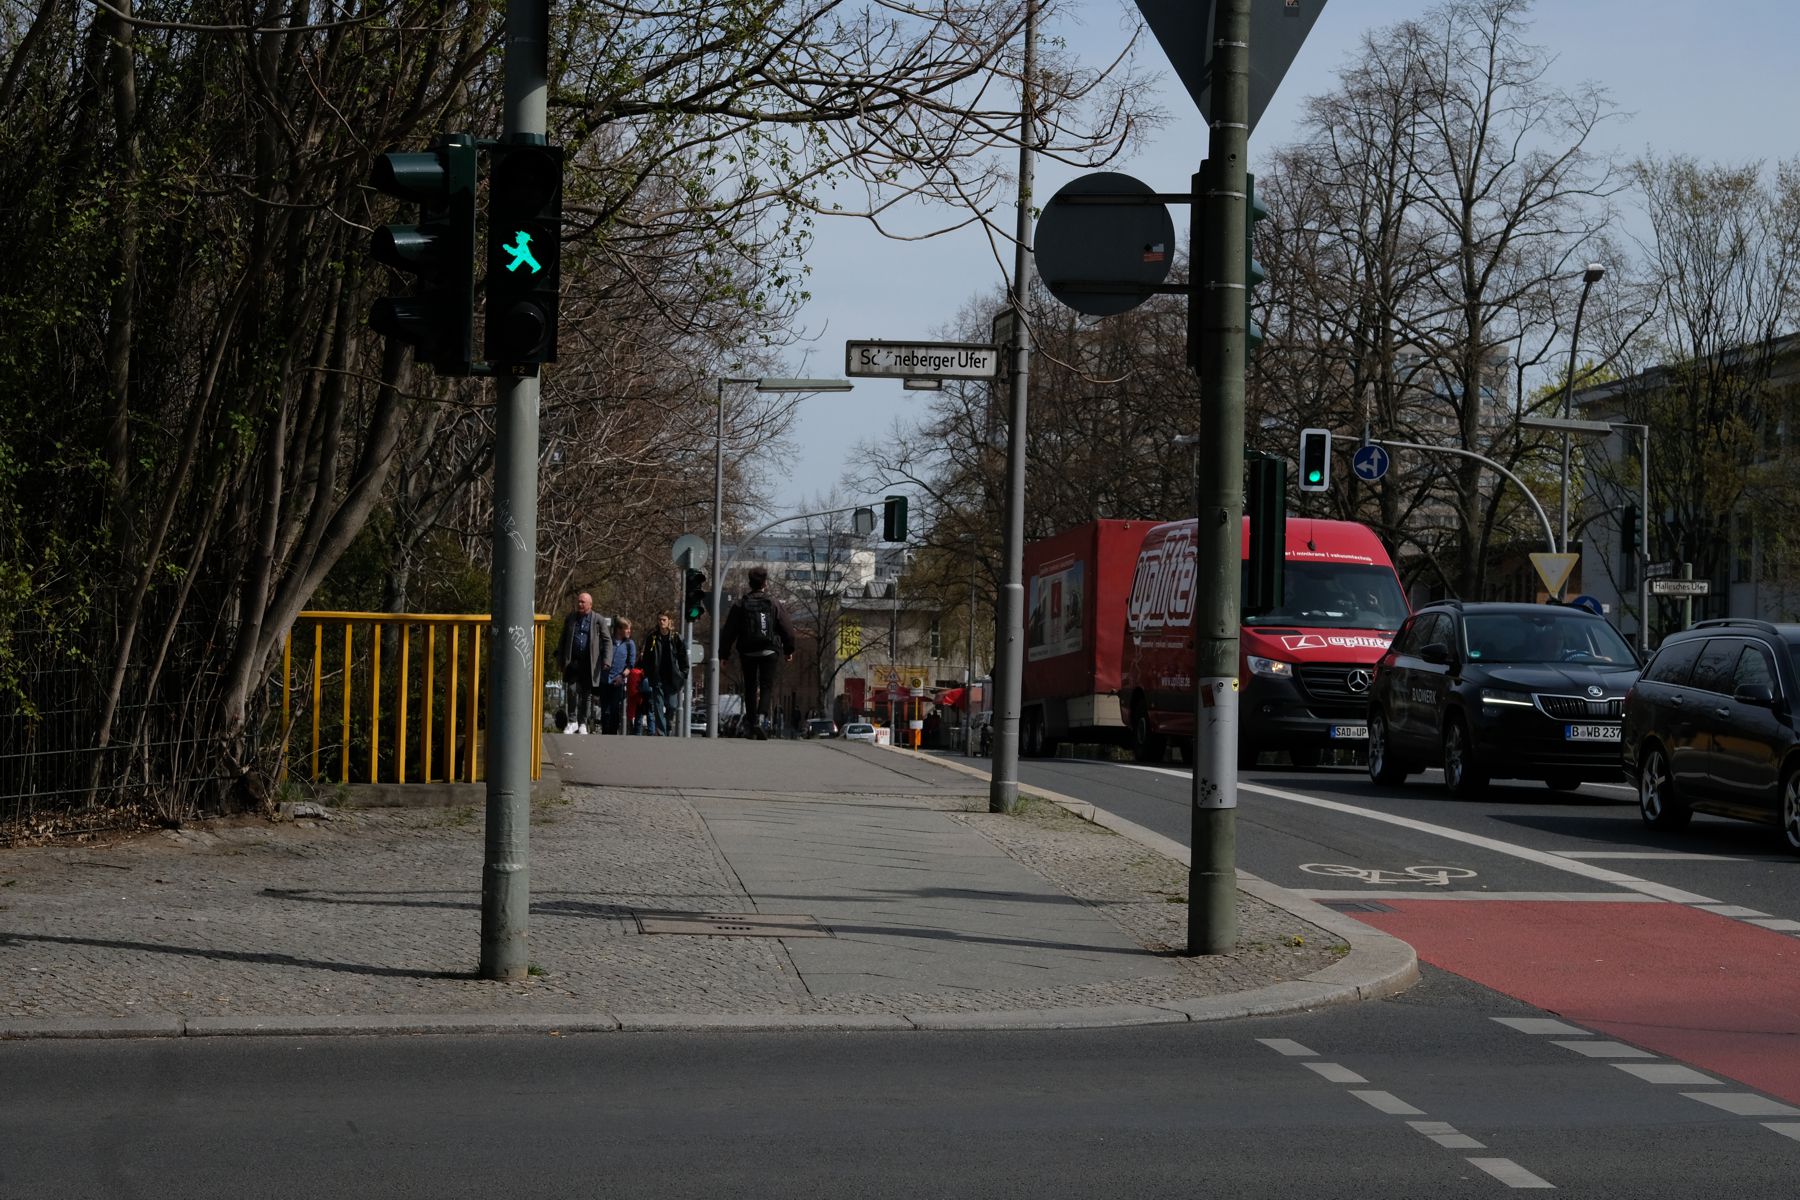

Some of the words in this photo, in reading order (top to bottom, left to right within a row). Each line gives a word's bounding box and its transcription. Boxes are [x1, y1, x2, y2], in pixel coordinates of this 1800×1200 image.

[860, 348, 956, 371] Scneberger
[957, 351, 988, 369] Ufer
[1655, 581, 1690, 591] Hallesches
[1691, 583, 1706, 591] Ufer
[1336, 727, 1352, 736] SAD
[1356, 727, 1367, 736] UP
[1572, 726, 1580, 737] B
[1586, 726, 1601, 738] WB
[1602, 727, 1622, 738] 237
